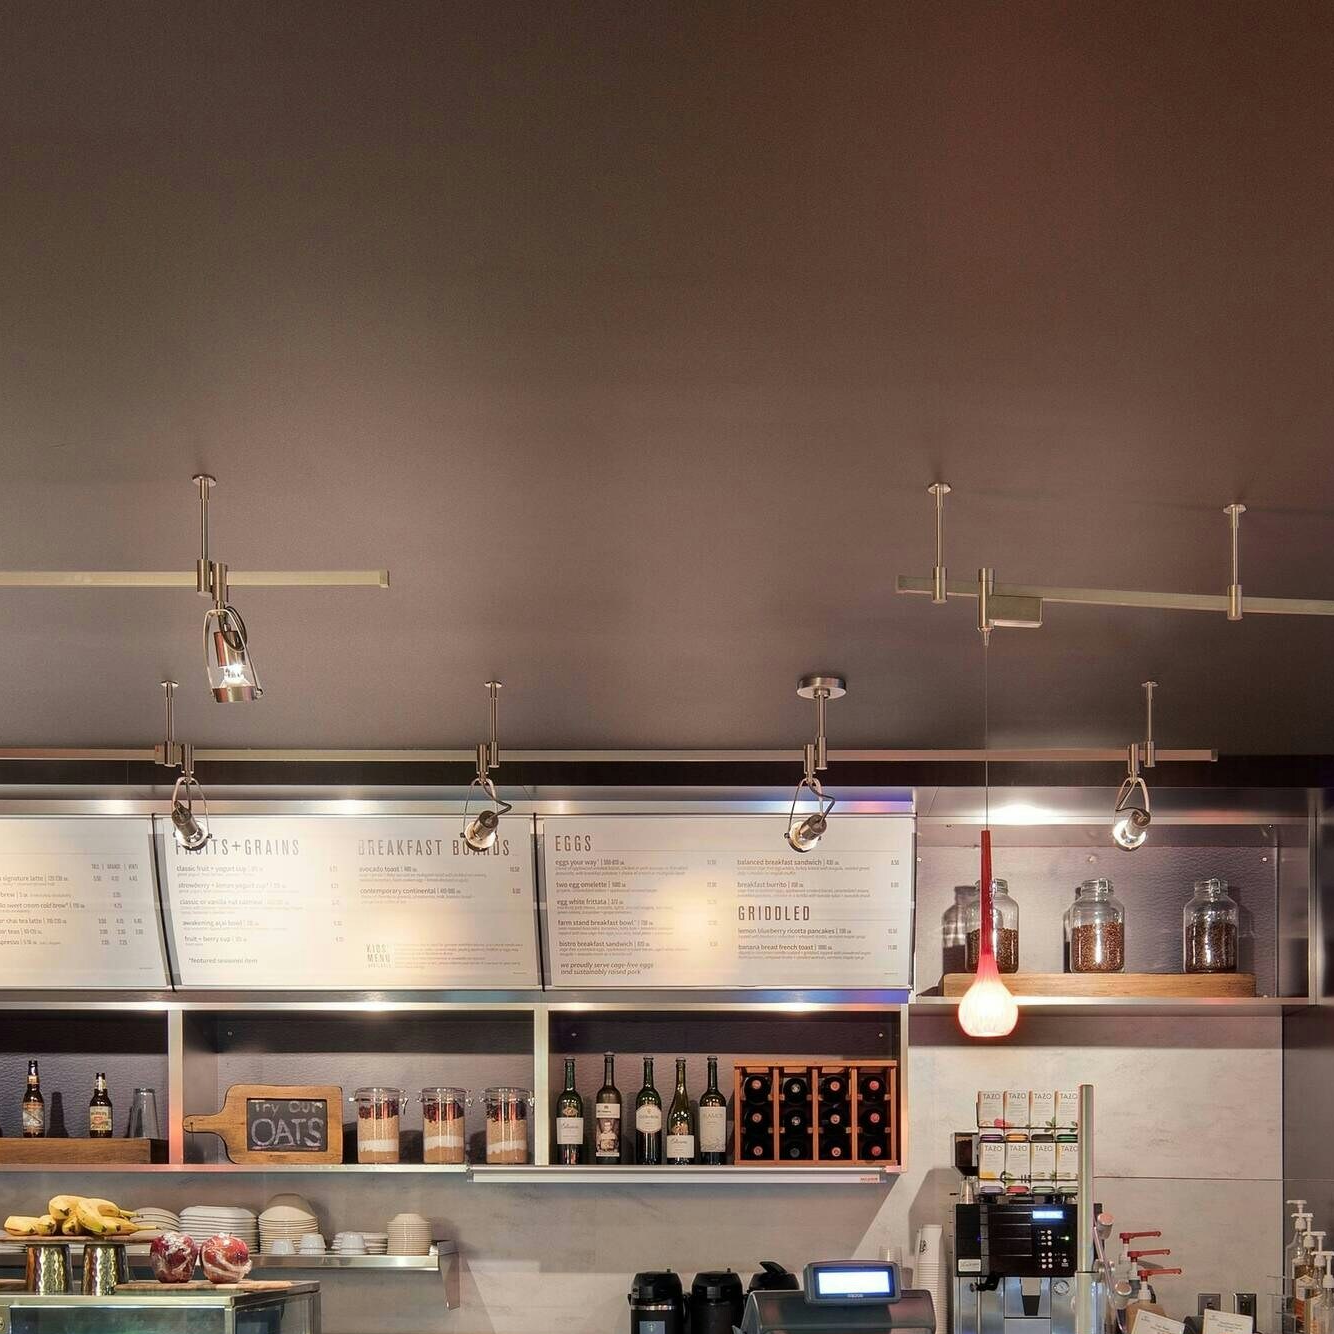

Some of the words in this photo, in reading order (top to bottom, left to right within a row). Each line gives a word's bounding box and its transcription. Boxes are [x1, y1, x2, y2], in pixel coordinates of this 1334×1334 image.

[554, 834, 592, 852] EGGS
[358, 839, 443, 856] BREAKFAST
[737, 858, 764, 866] balanced
[764, 858, 793, 866] breakfast
[793, 858, 822, 866] sandwich
[178, 882, 210, 890] strawberry
[402, 887, 436, 895] continental
[738, 905, 810, 921] GRIDDLED
[182, 920, 214, 928] awakening
[757, 928, 787, 936] blueberry
[807, 928, 835, 936] pancakes
[184, 935, 197, 943] fruit
[202, 935, 219, 944] berry
[570, 962, 593, 970] proudly
[639, 962, 654, 970] eggs
[573, 969, 608, 977] sustainably
[251, 1117, 324, 1147] OATS
